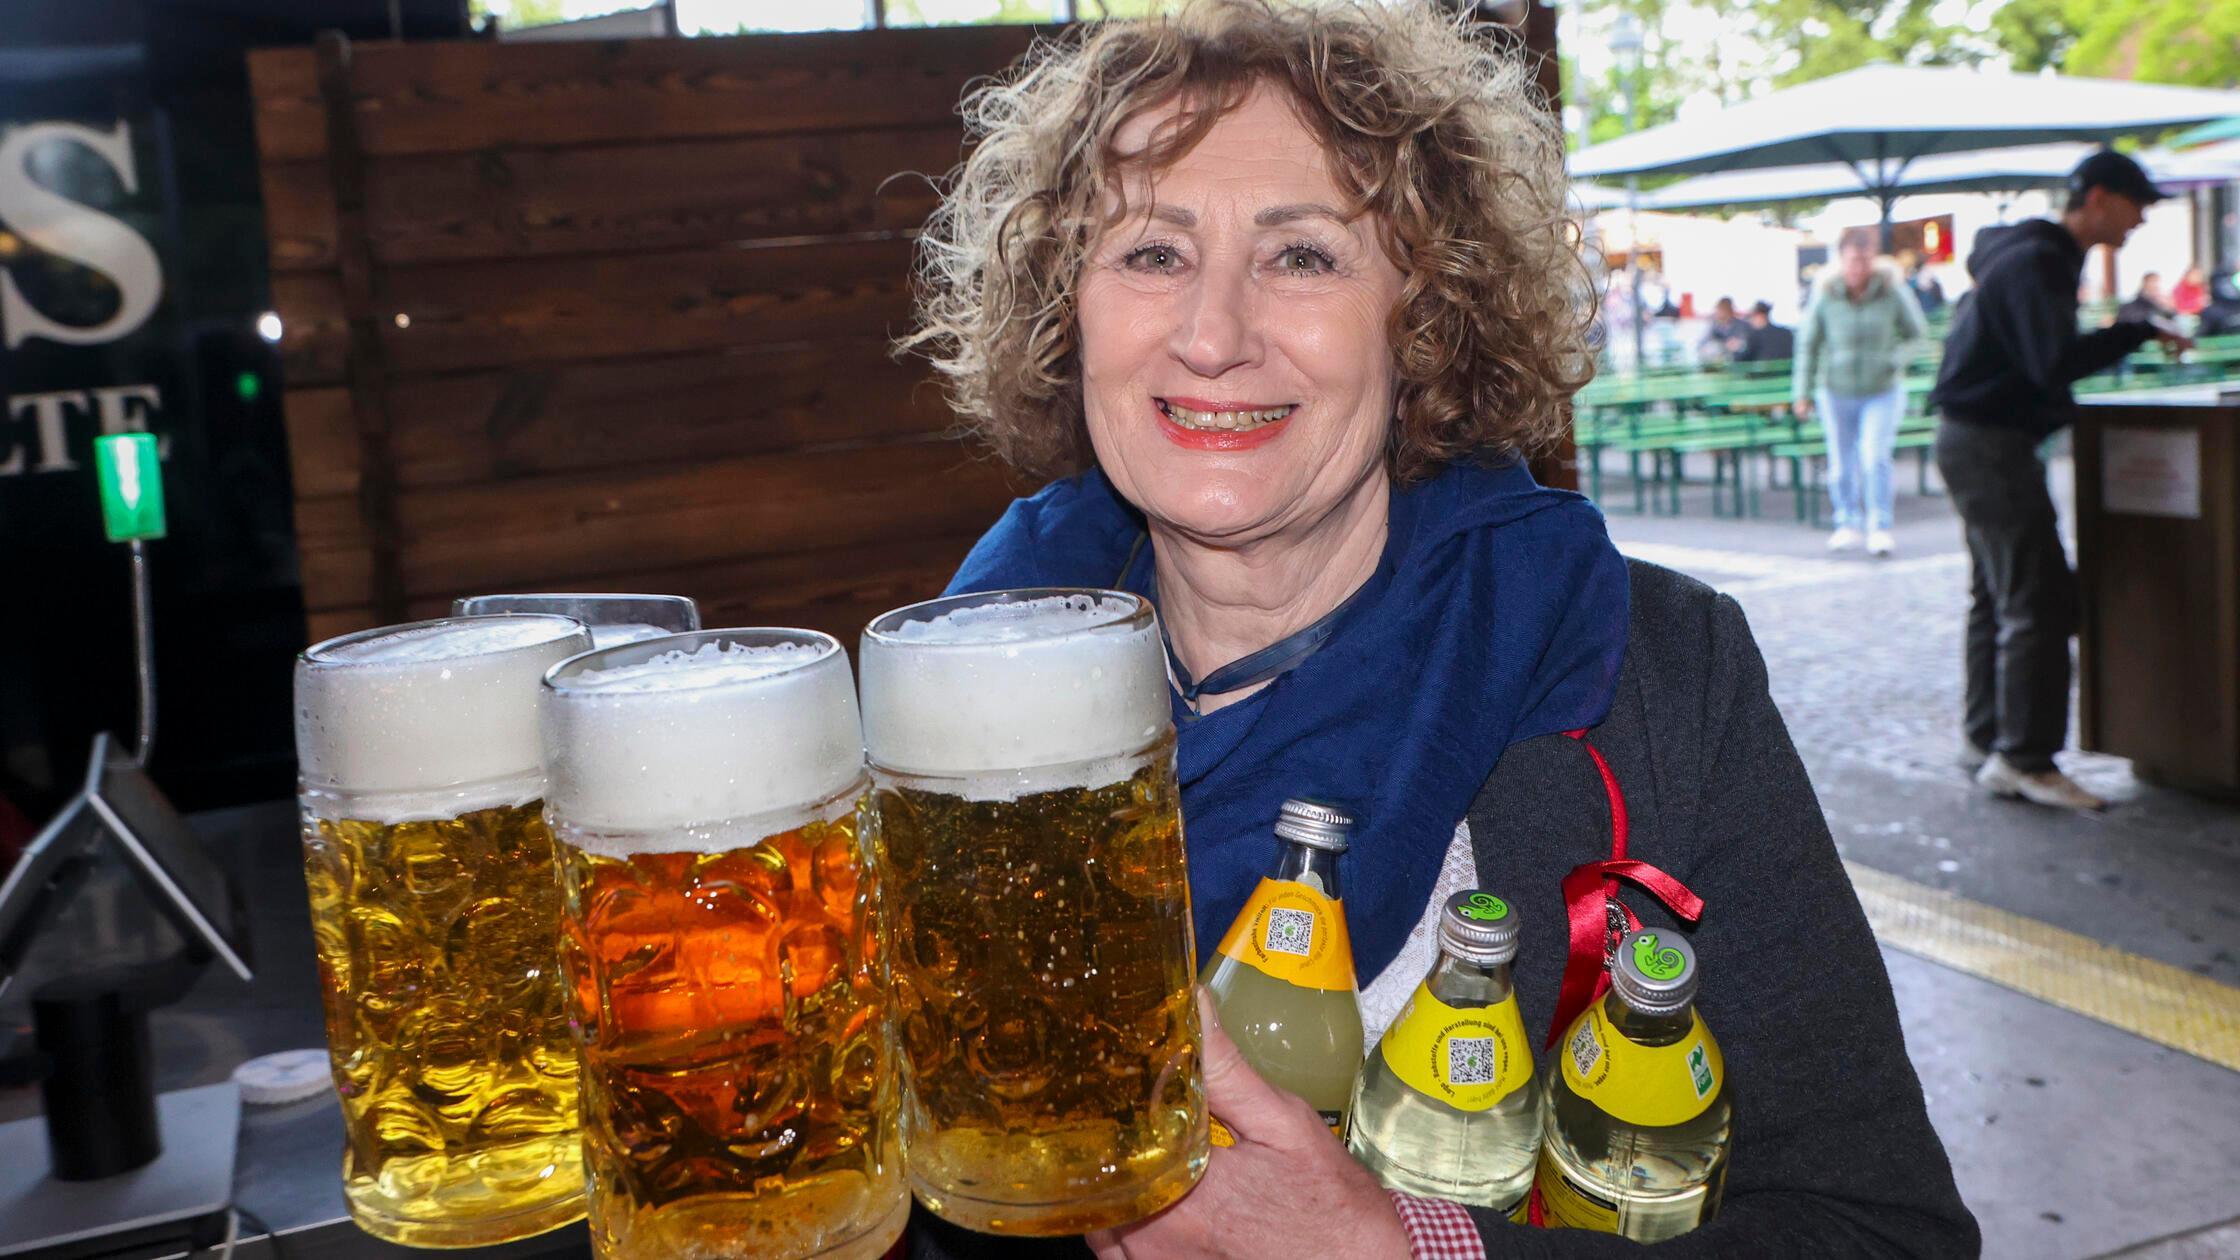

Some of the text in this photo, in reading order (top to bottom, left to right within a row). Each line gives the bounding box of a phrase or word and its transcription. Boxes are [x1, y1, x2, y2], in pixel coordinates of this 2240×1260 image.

[0, 119, 164, 347] S
[1443, 1019, 1482, 1034] Herstellung
[1482, 1021, 1497, 1032] sind
